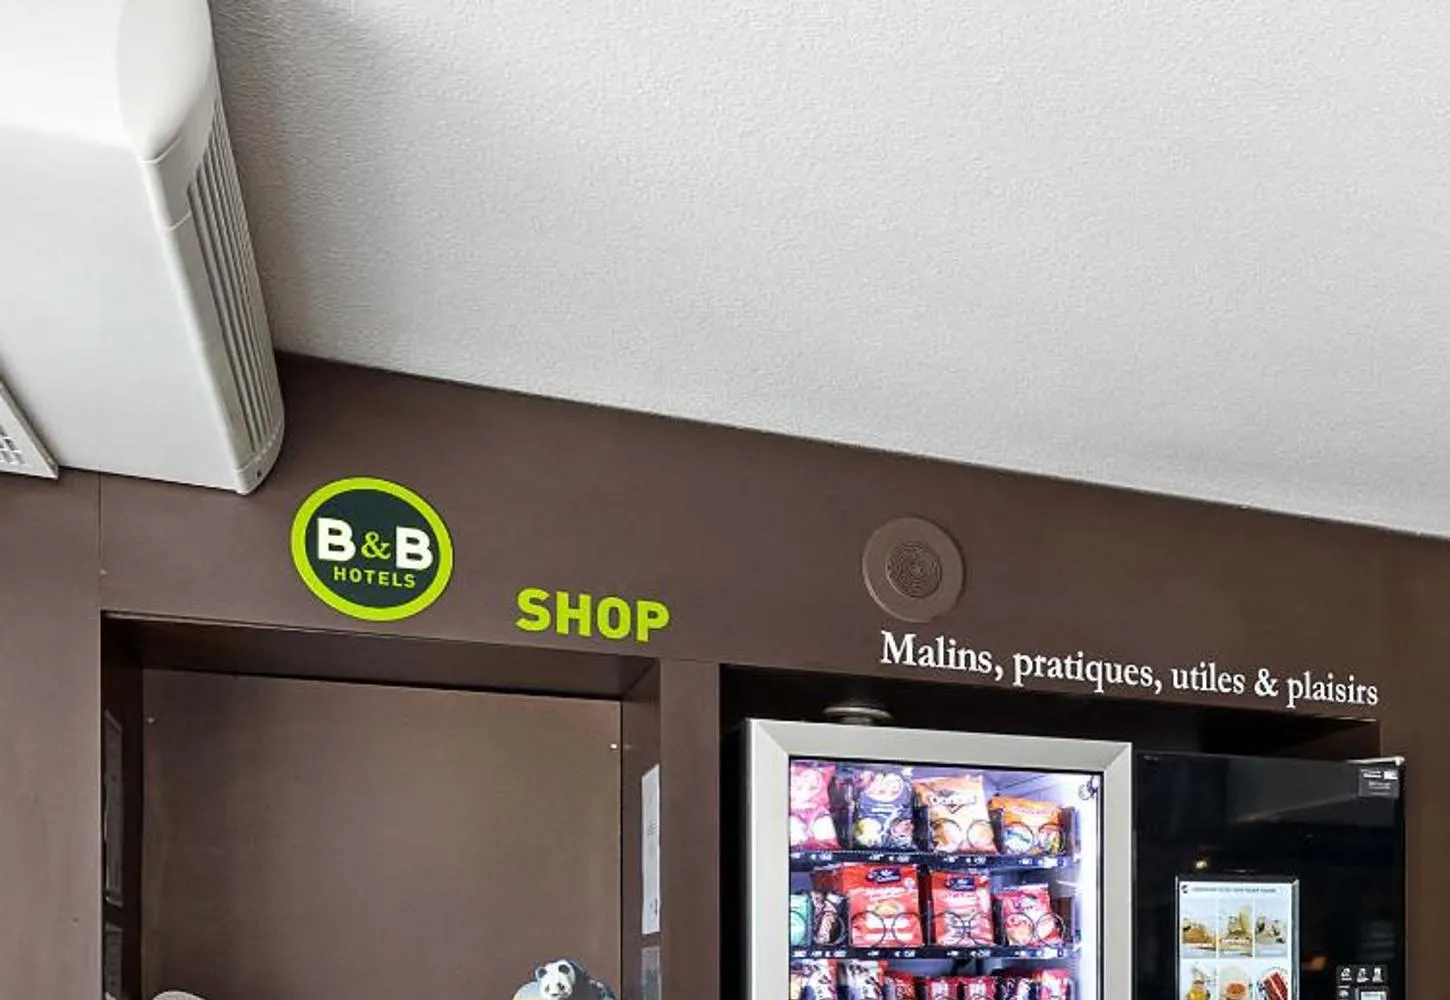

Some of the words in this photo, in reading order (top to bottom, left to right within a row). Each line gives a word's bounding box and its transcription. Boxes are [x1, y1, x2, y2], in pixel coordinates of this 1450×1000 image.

[332, 566, 416, 589] HOTELS
[515, 586, 670, 643] SHOP
[881, 630, 1004, 682] Malins,
[1012, 651, 1162, 693] pratiques,
[1171, 662, 1245, 696] utiles
[1253, 668, 1279, 697] &
[1286, 672, 1379, 708] plaisirs
